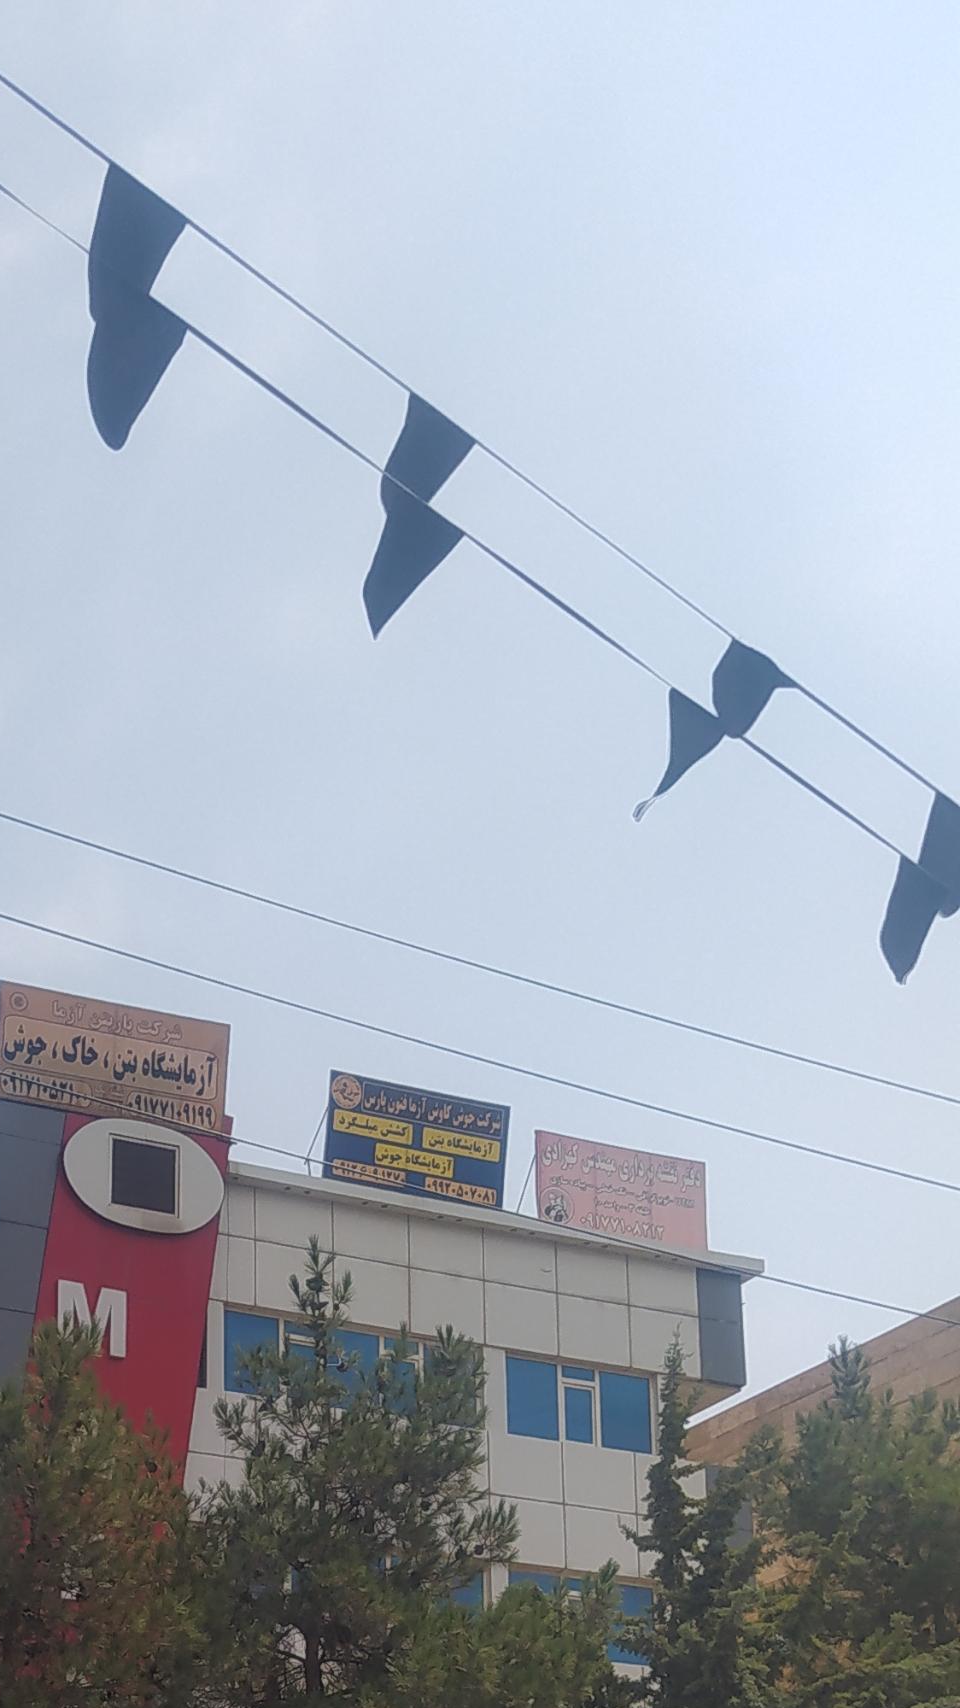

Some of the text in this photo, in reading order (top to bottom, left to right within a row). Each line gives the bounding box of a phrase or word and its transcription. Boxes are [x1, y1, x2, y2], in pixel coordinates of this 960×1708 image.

[3, 1023, 47, 1066] جوش
[62, 1034, 98, 1066] خاک
[142, 1048, 218, 1096] آزمایشگاه
[364, 1089, 386, 1112] پارس
[477, 1112, 502, 1134] شرکت
[447, 1137, 493, 1157] آزمایشگاه
[406, 1153, 452, 1175] آزمایشگاه
